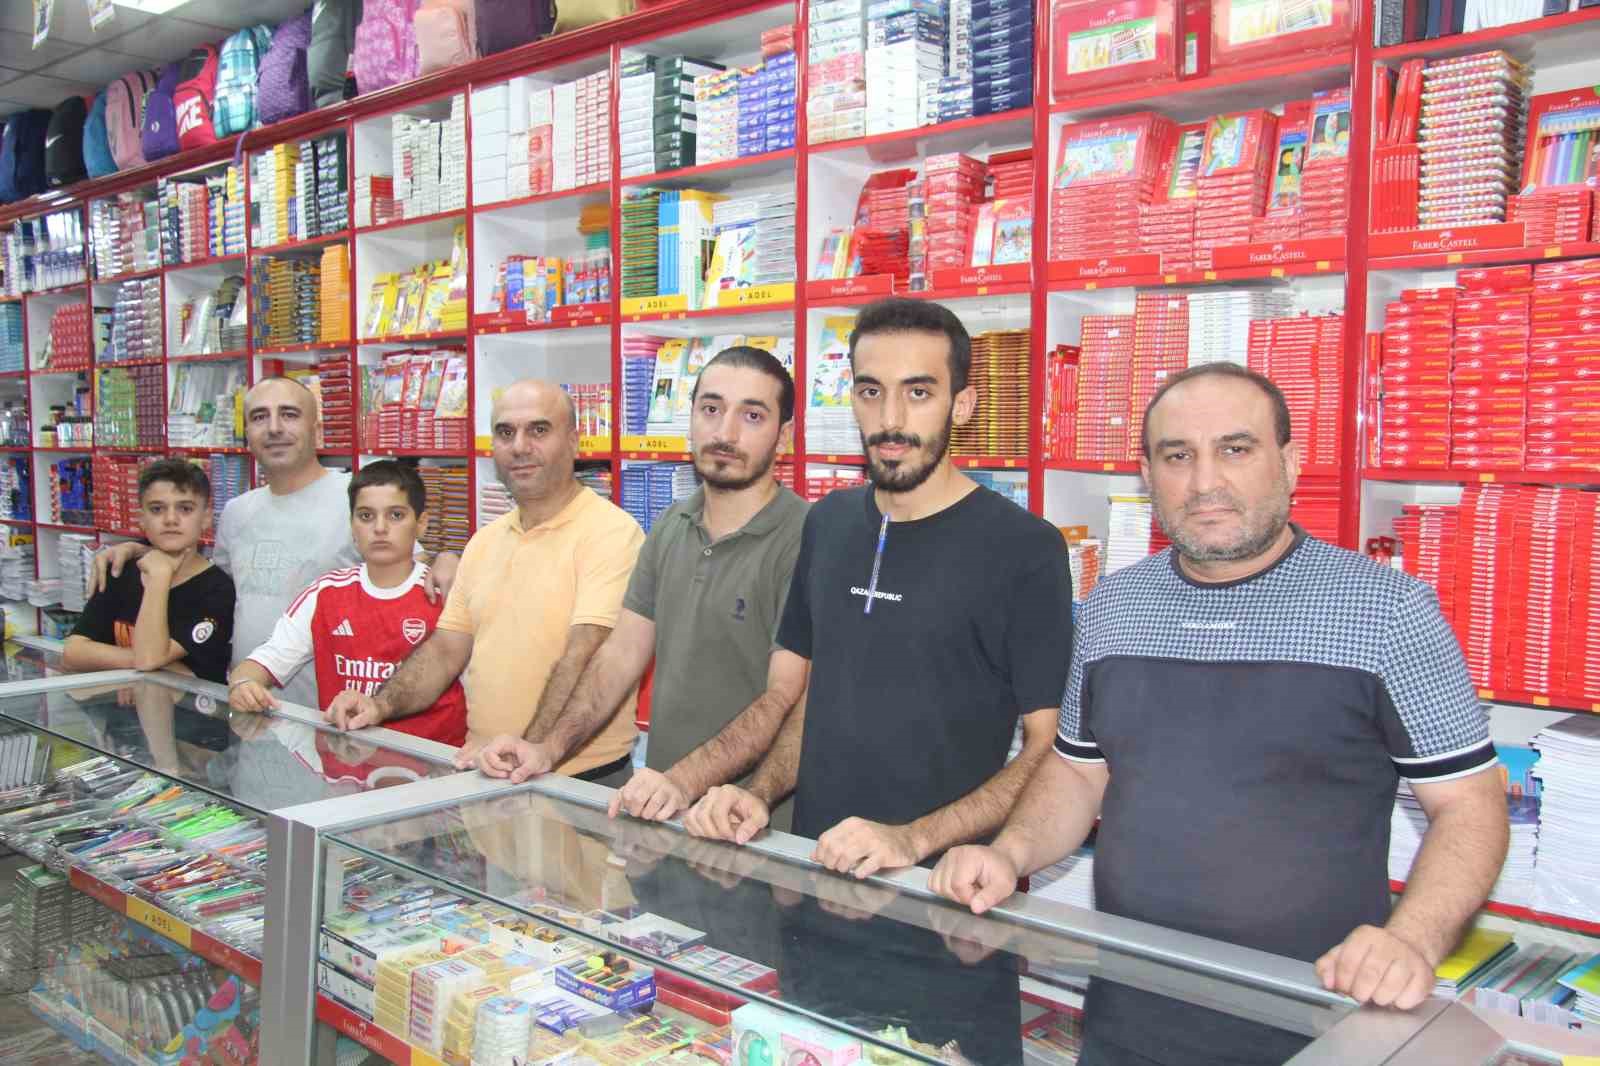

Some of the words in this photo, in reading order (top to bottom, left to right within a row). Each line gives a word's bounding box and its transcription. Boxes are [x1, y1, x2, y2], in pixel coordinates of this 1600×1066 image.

[747, 290, 773, 299] ADEL
[647, 300, 668, 309] ADEL
[646, 439, 668, 449] ADEL
[334, 653, 402, 680] Emira
